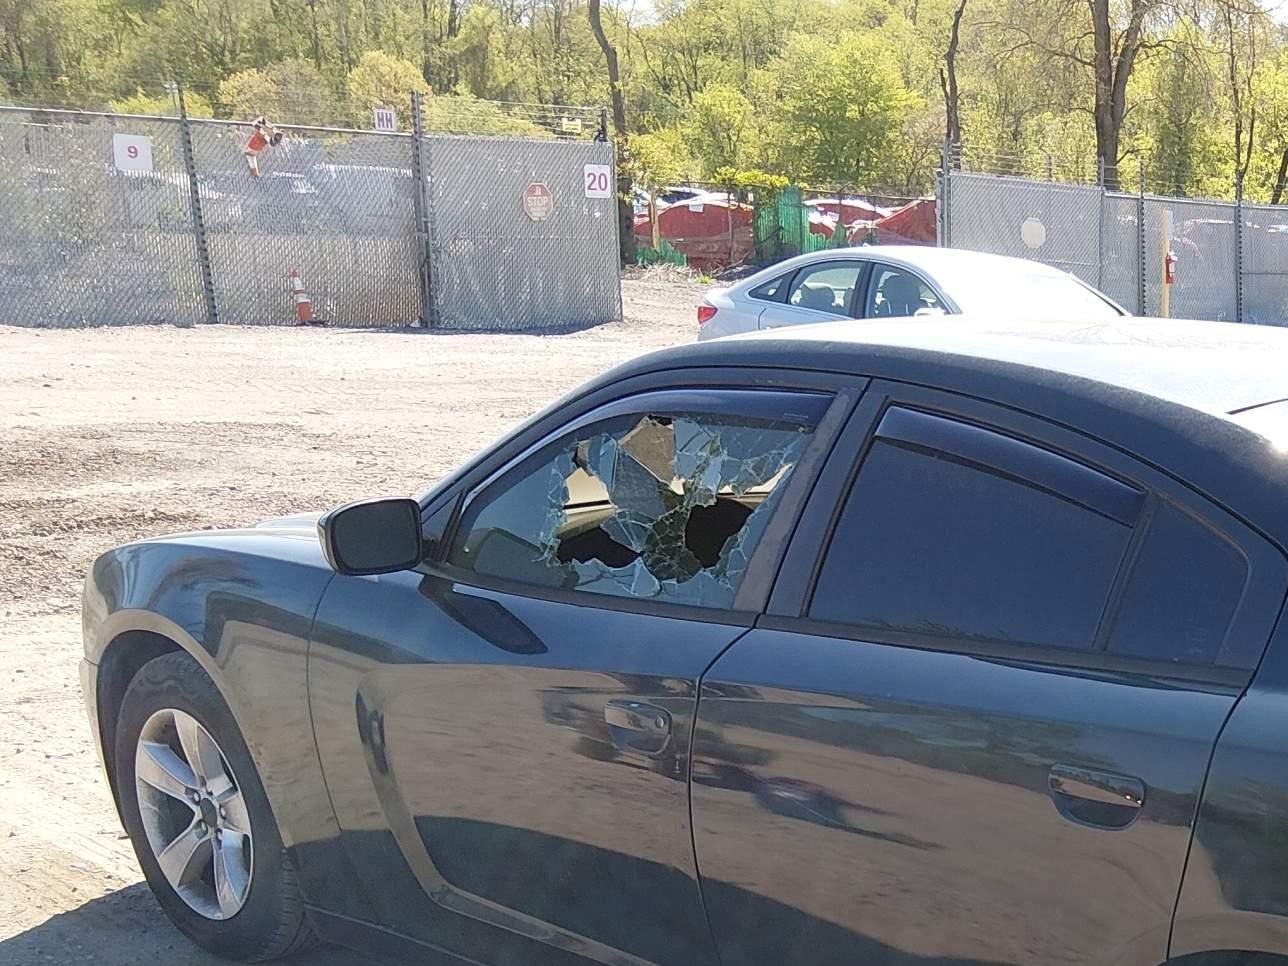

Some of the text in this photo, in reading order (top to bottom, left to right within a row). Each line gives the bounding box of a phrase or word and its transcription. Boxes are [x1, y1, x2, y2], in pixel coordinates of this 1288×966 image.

[377, 111, 393, 128] HH
[127, 145, 138, 159] 9
[587, 172, 608, 191] 20
[527, 196, 548, 207] STOP
